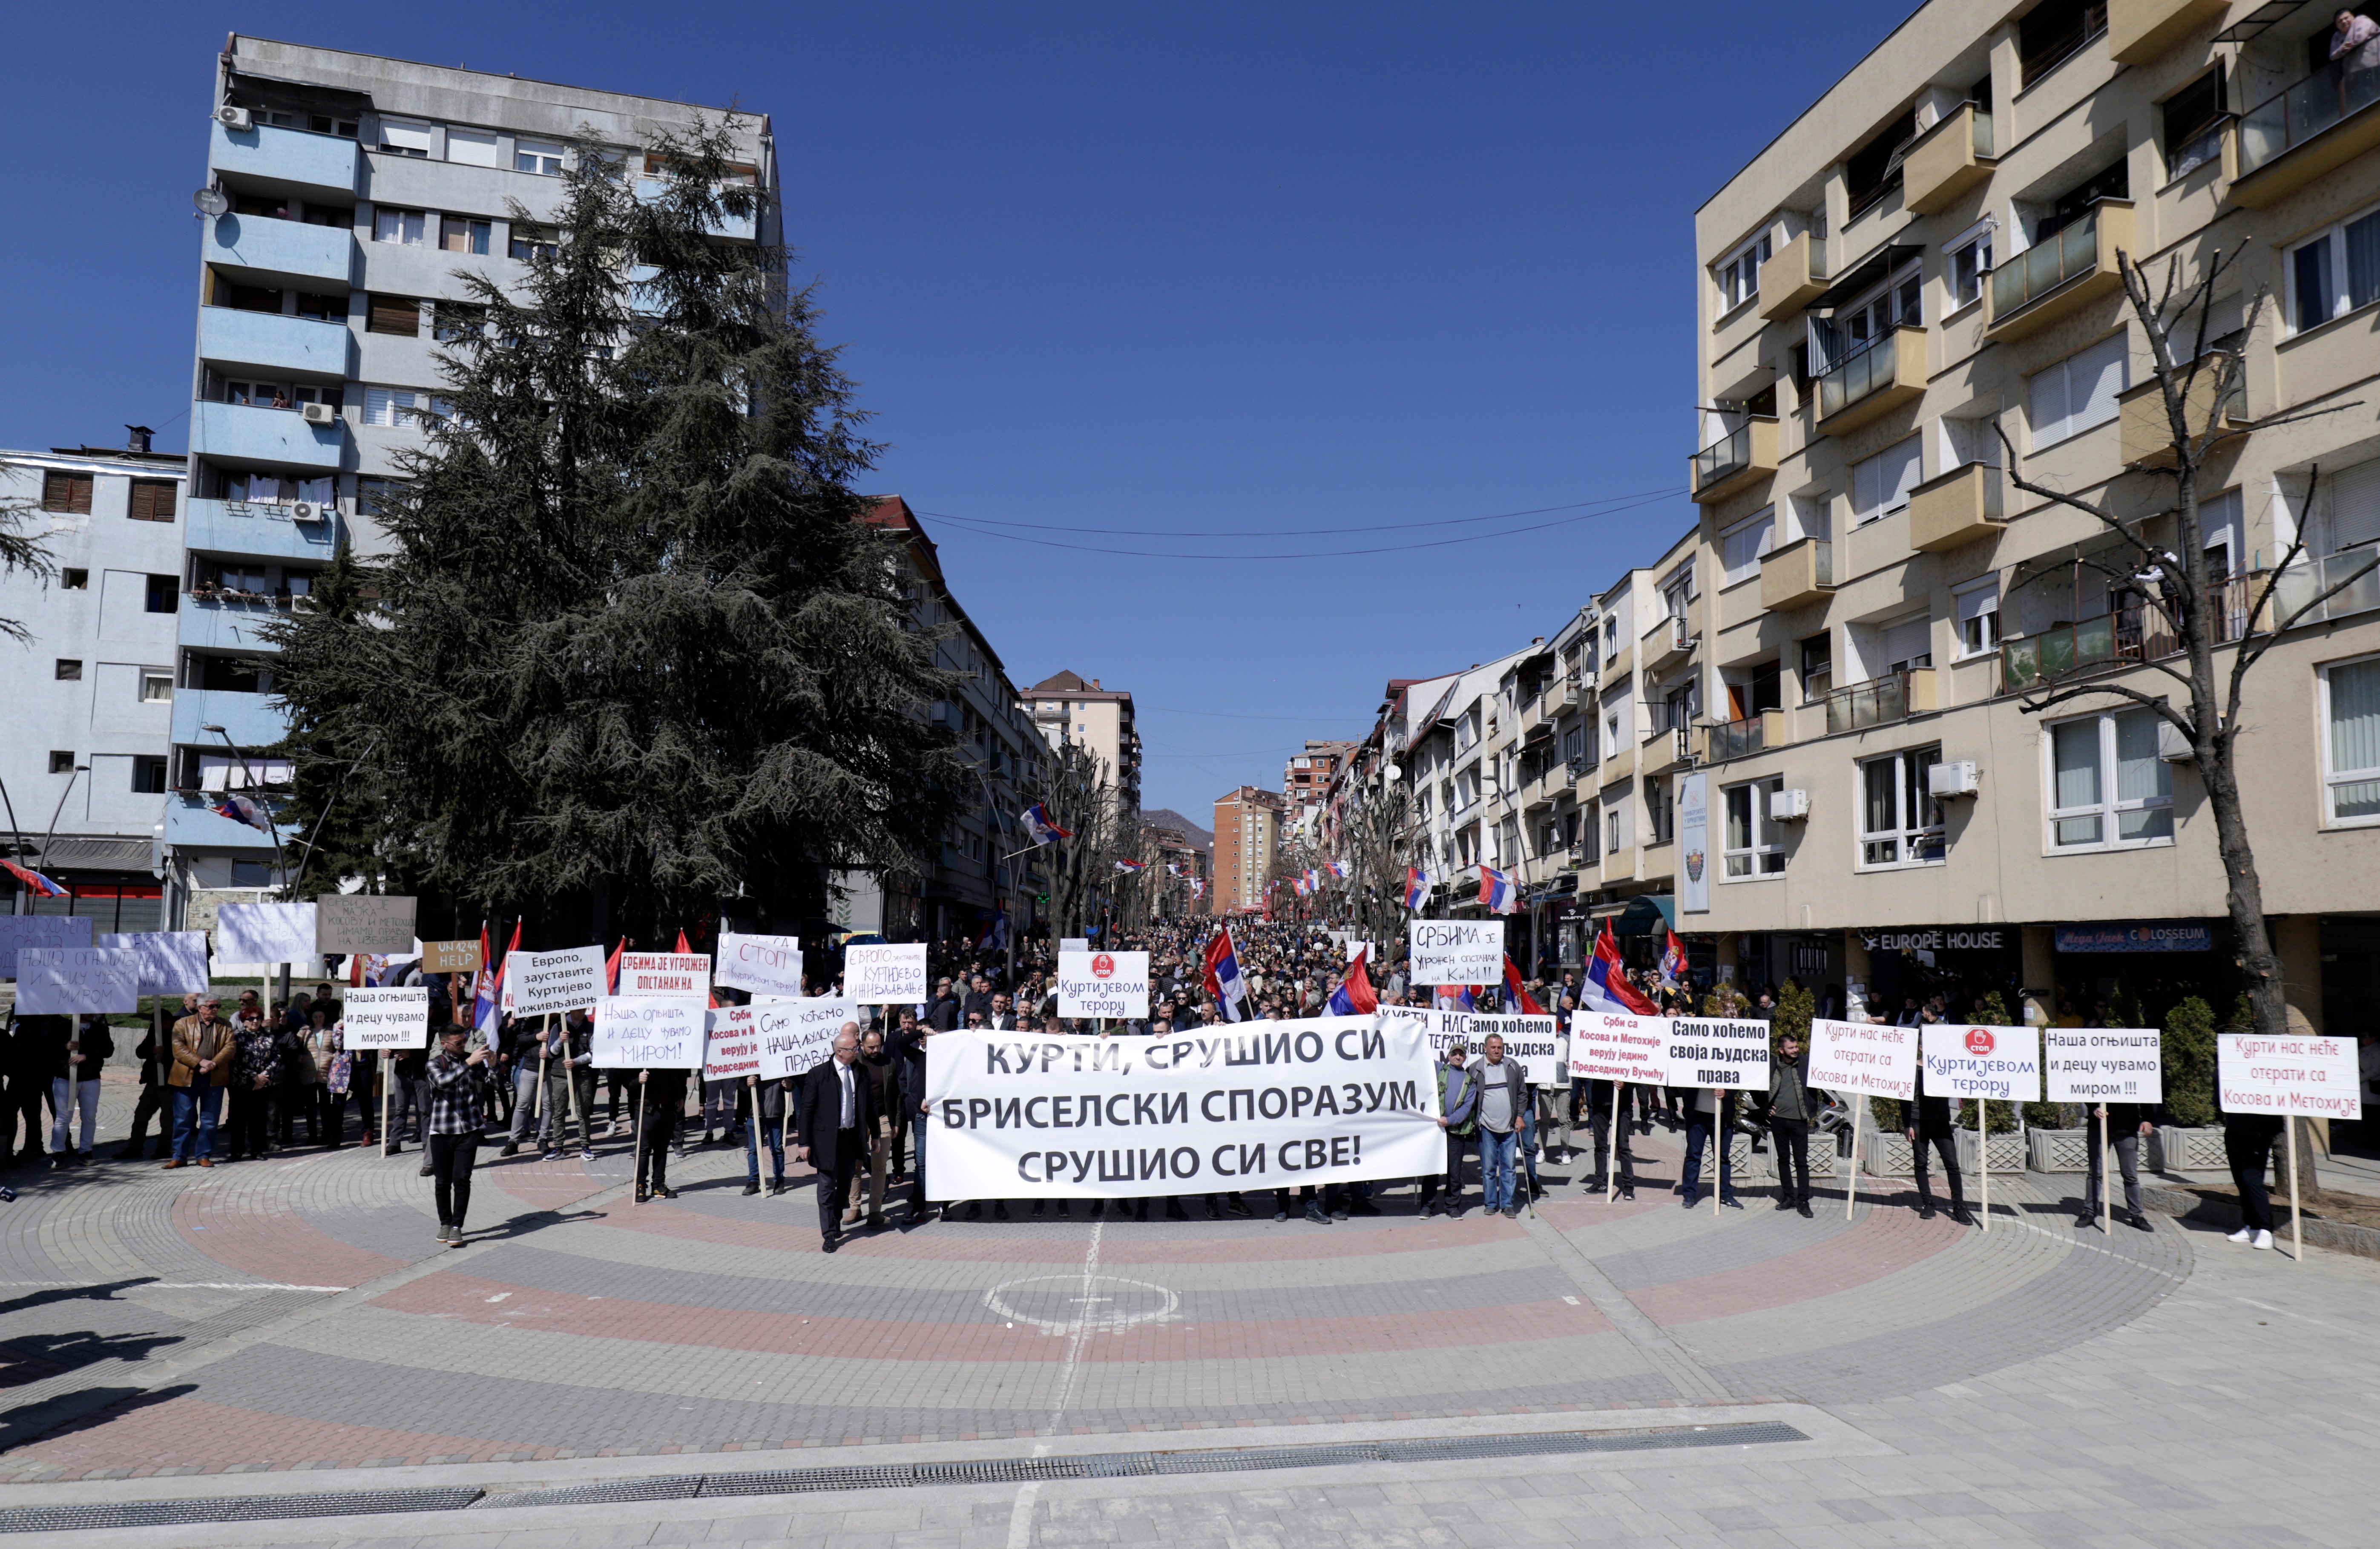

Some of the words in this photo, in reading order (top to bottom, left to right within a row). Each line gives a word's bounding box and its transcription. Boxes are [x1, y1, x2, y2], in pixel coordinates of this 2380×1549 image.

[327, 898, 372, 907] СРБИЈА
[377, 899, 389, 910] ЈЕ
[343, 907, 377, 916] МАЈКА
[328, 917, 363, 925] КОСОВУ
[337, 927, 373, 936] ИМАМО
[1417, 926, 1479, 948] СРБИМА
[2061, 932, 2093, 945] Mega
[338, 937, 351, 945] НА
[456, 941, 477, 952] 1244
[1881, 933, 1944, 950] EUROPE
[1947, 932, 2004, 949] HOUSE
[440, 953, 474, 967] HELP
[532, 954, 582, 967] Европо,
[623, 956, 656, 970] СРБИМА
[658, 957, 667, 970] ЈЕ
[670, 957, 708, 971] УГРОЖЕН
[740, 943, 786, 970] СТОП
[524, 967, 593, 984] зауставите
[638, 976, 680, 990] ОПСТАНАК
[682, 977, 692, 990] НА
[528, 982, 592, 999] Куртијево
[1061, 979, 1144, 998] Куртијевом
[57, 989, 113, 1005] МИРОМ
[345, 992, 375, 1002] Наша
[379, 993, 426, 1002] огњишта
[519, 996, 598, 1014] иживљавањ
[730, 1010, 751, 1022] Срби
[1080, 1001, 1124, 1016] терору
[356, 1014, 383, 1025] децу
[386, 1013, 425, 1025] чувамо
[1442, 1014, 1469, 1034] НАС
[1502, 1019, 1552, 1034] хоћемо
[1604, 1016, 1625, 1028] Срби
[708, 1028, 739, 1040] Косова
[1673, 1020, 1709, 1037] Само
[1713, 1023, 1765, 1039] хоћемо
[1825, 1022, 1856, 1041] Курти
[1860, 1029, 1878, 1040] нас
[1882, 1028, 1905, 1043] неће
[362, 1034, 398, 1045] миром
[1580, 1030, 1610, 1041] Косова
[1621, 1034, 1661, 1048] Метохије
[2048, 1033, 2087, 1046] Наша
[2091, 1037, 2158, 1047] огњишта
[621, 1042, 681, 1064] МИРОМ!
[721, 1043, 748, 1057] верују
[987, 1042, 1132, 1076] КУРТИ,
[1145, 1031, 1323, 1069] СРУШИО
[1335, 1030, 1385, 1060] СИ
[1590, 1048, 1616, 1060] верују
[1618, 1049, 1648, 1061] једино
[1670, 1044, 1707, 1060] своја
[1711, 1048, 1767, 1063] људска
[2235, 1037, 2276, 1058] Курти
[2281, 1042, 2305, 1054] нас
[2310, 1039, 2340, 1056] неће
[1834, 1050, 1876, 1066] отерати
[1880, 1055, 1891, 1065] са
[1927, 1054, 2035, 1077] Куртијевом
[706, 1060, 759, 1076] Председник
[1572, 1061, 1630, 1078] Председнику
[1633, 1066, 1664, 1081] Вучићу
[2051, 1060, 2058, 1070] и
[2063, 1060, 2097, 1074] децу
[2101, 1060, 2157, 1074] чувамо
[1698, 1070, 1740, 1084] права
[1811, 1067, 1847, 1084] Косова
[1851, 1075, 1858, 1085] и
[1862, 1073, 1912, 1097] Метохије
[2251, 1068, 2305, 1085] отерати
[2311, 1070, 2326, 1082] са
[1952, 1079, 2009, 1098] терору
[2071, 1084, 2121, 1097] миром
[943, 1092, 1187, 1129] БРИСЕЛСКИ
[1201, 1081, 1426, 1122] СПОРАЗУМ,
[2224, 1089, 2272, 1106] Косова
[2277, 1095, 2285, 1107] и
[2290, 1092, 2357, 1117] Метохије
[1018, 1147, 1200, 1183] СРУШИО
[1212, 1143, 1265, 1176] СИ
[1278, 1135, 1360, 1171] СВЕ!
